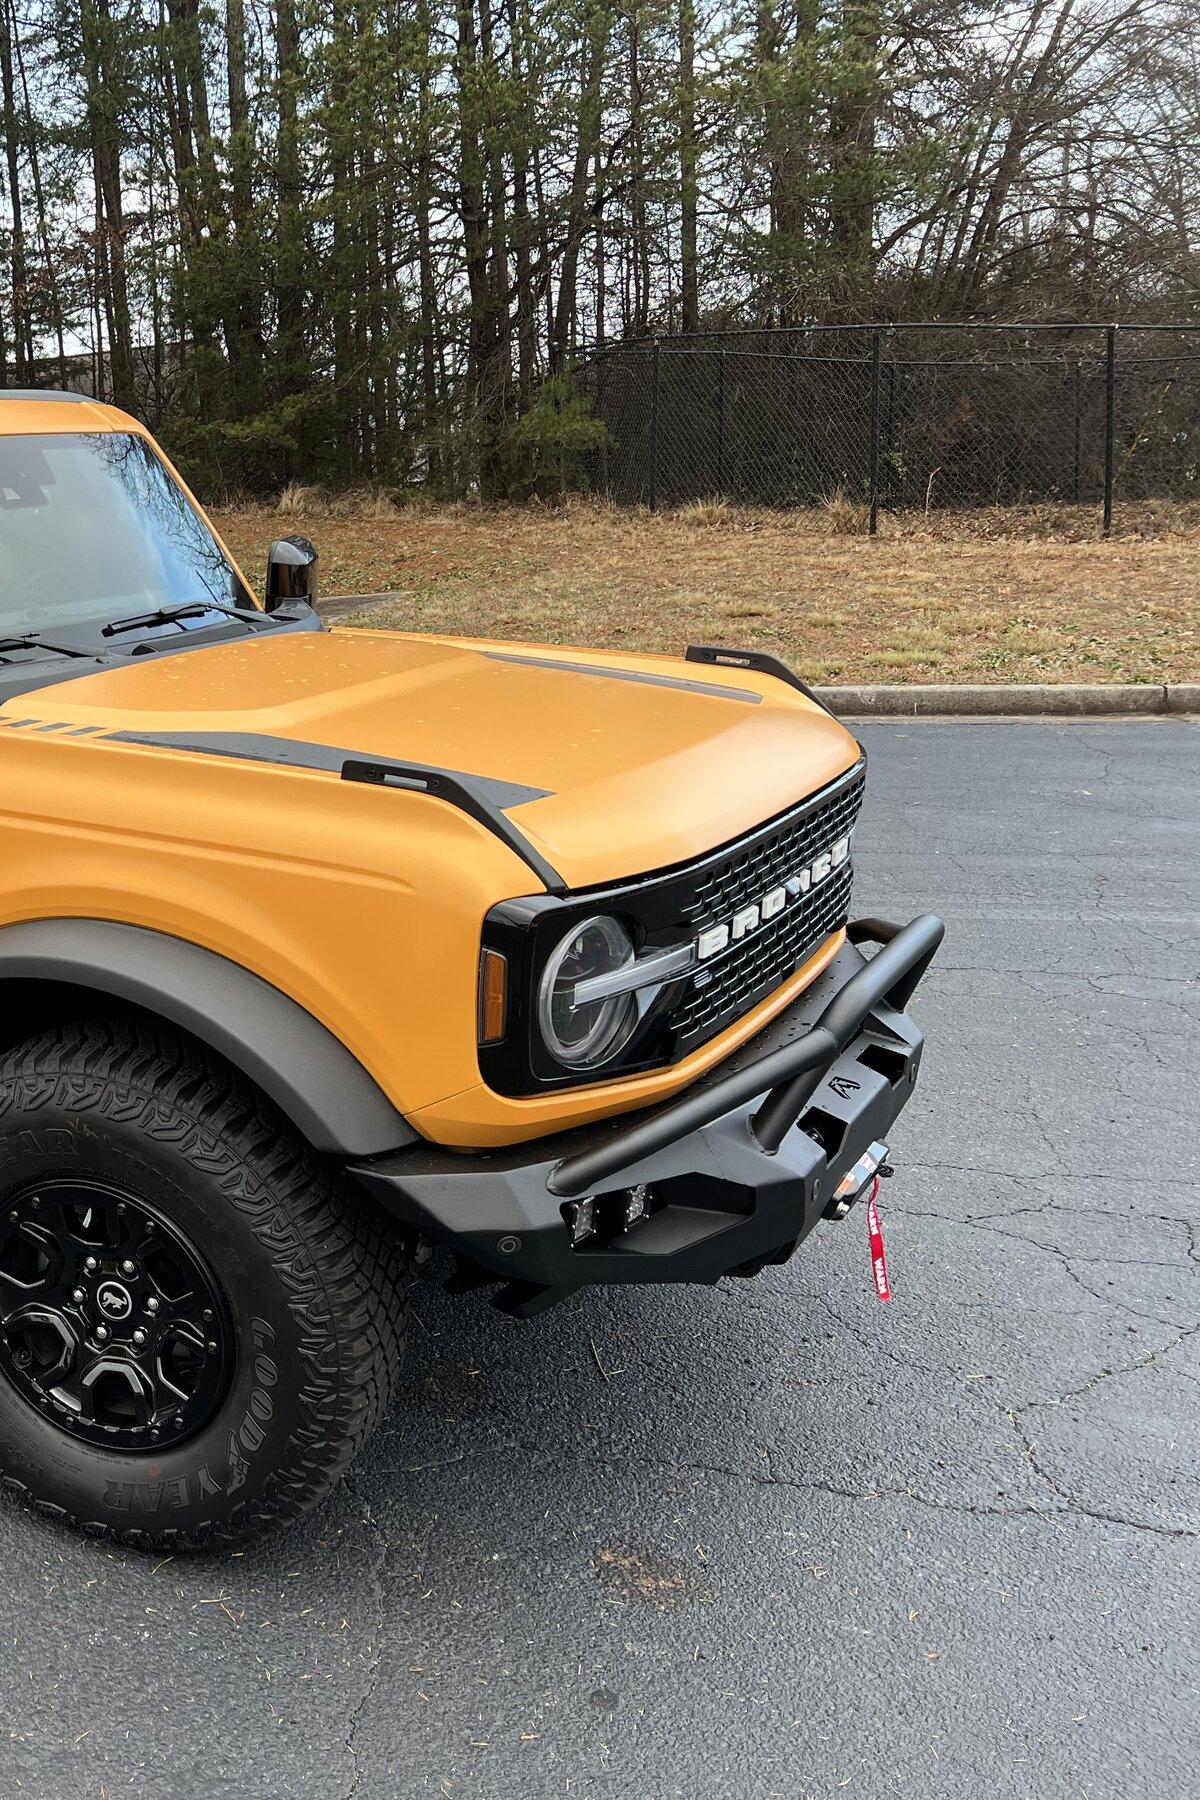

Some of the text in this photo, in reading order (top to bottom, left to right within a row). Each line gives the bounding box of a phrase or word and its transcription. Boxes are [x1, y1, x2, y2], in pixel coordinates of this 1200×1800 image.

[698, 838, 849, 960] BRONCO
[874, 1258, 887, 1295] WARN
[102, 1316, 279, 1513] GOODYEAR
